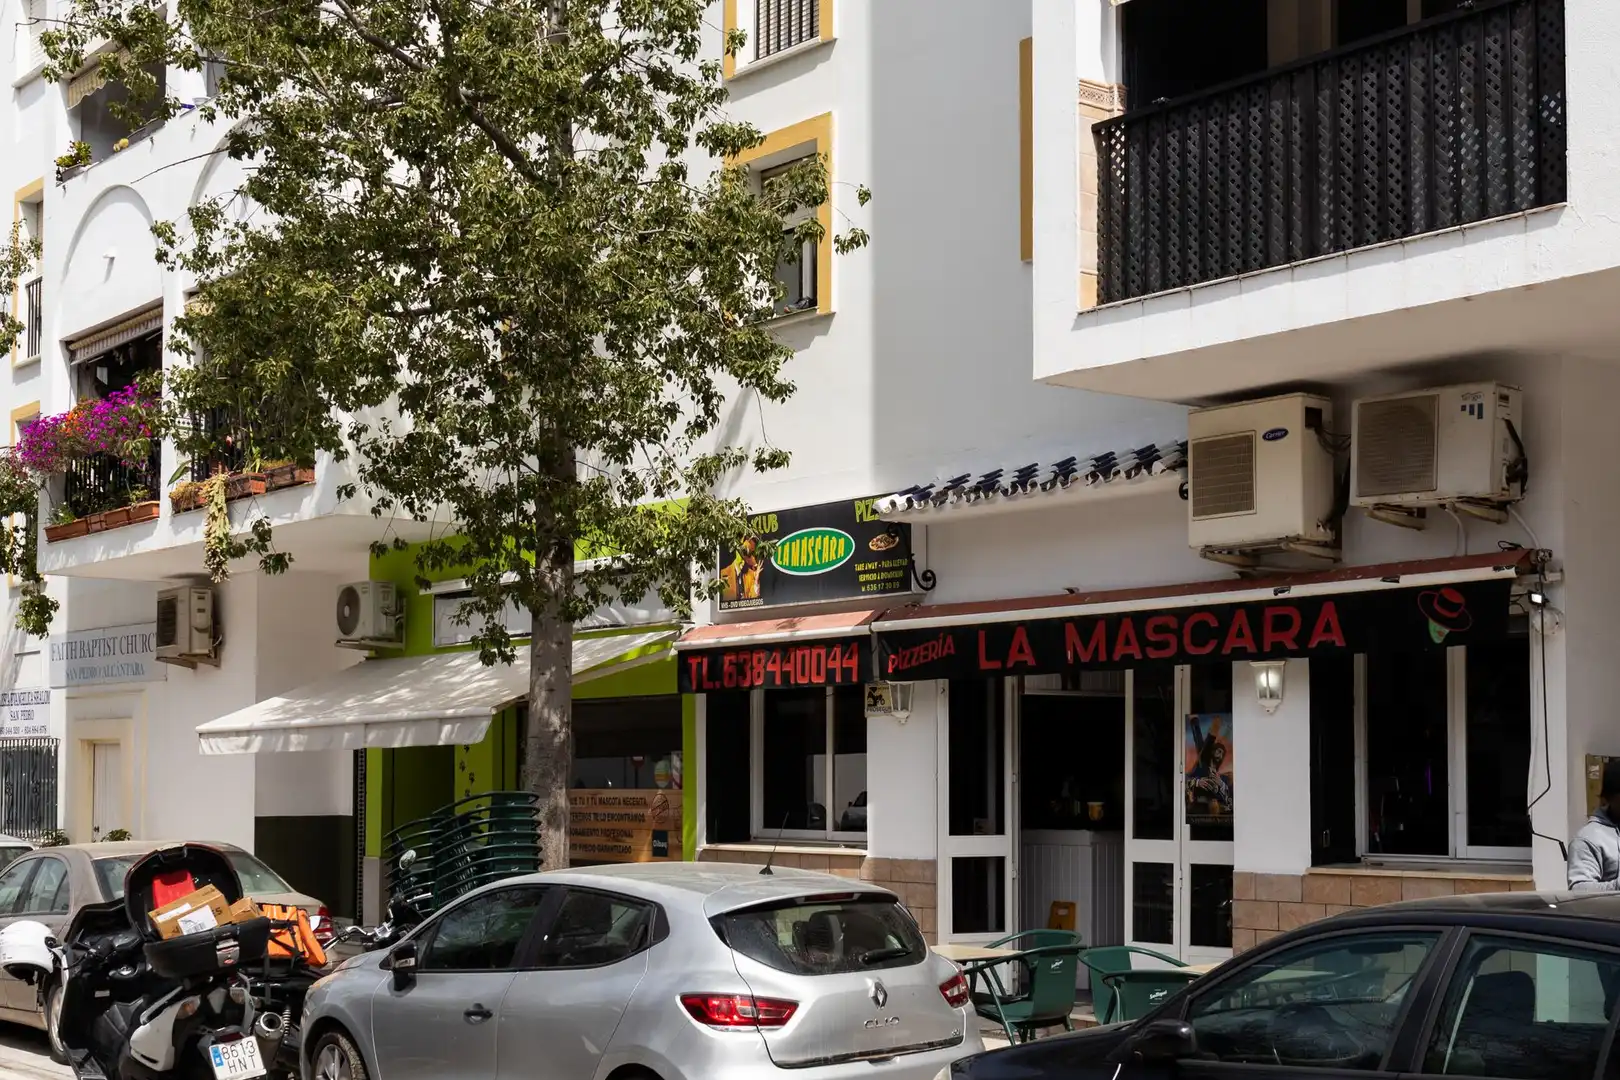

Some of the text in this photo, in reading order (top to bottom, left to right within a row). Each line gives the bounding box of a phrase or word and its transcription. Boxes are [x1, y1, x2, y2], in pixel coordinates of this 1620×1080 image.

[977, 601, 1347, 670] LA MASCARA
[51, 632, 158, 661] FAITH BAPTIST CHURC
[863, 1016, 900, 1030] CLIO
[221, 1040, 256, 1060] 8613
[227, 1054, 256, 1074] HNT
